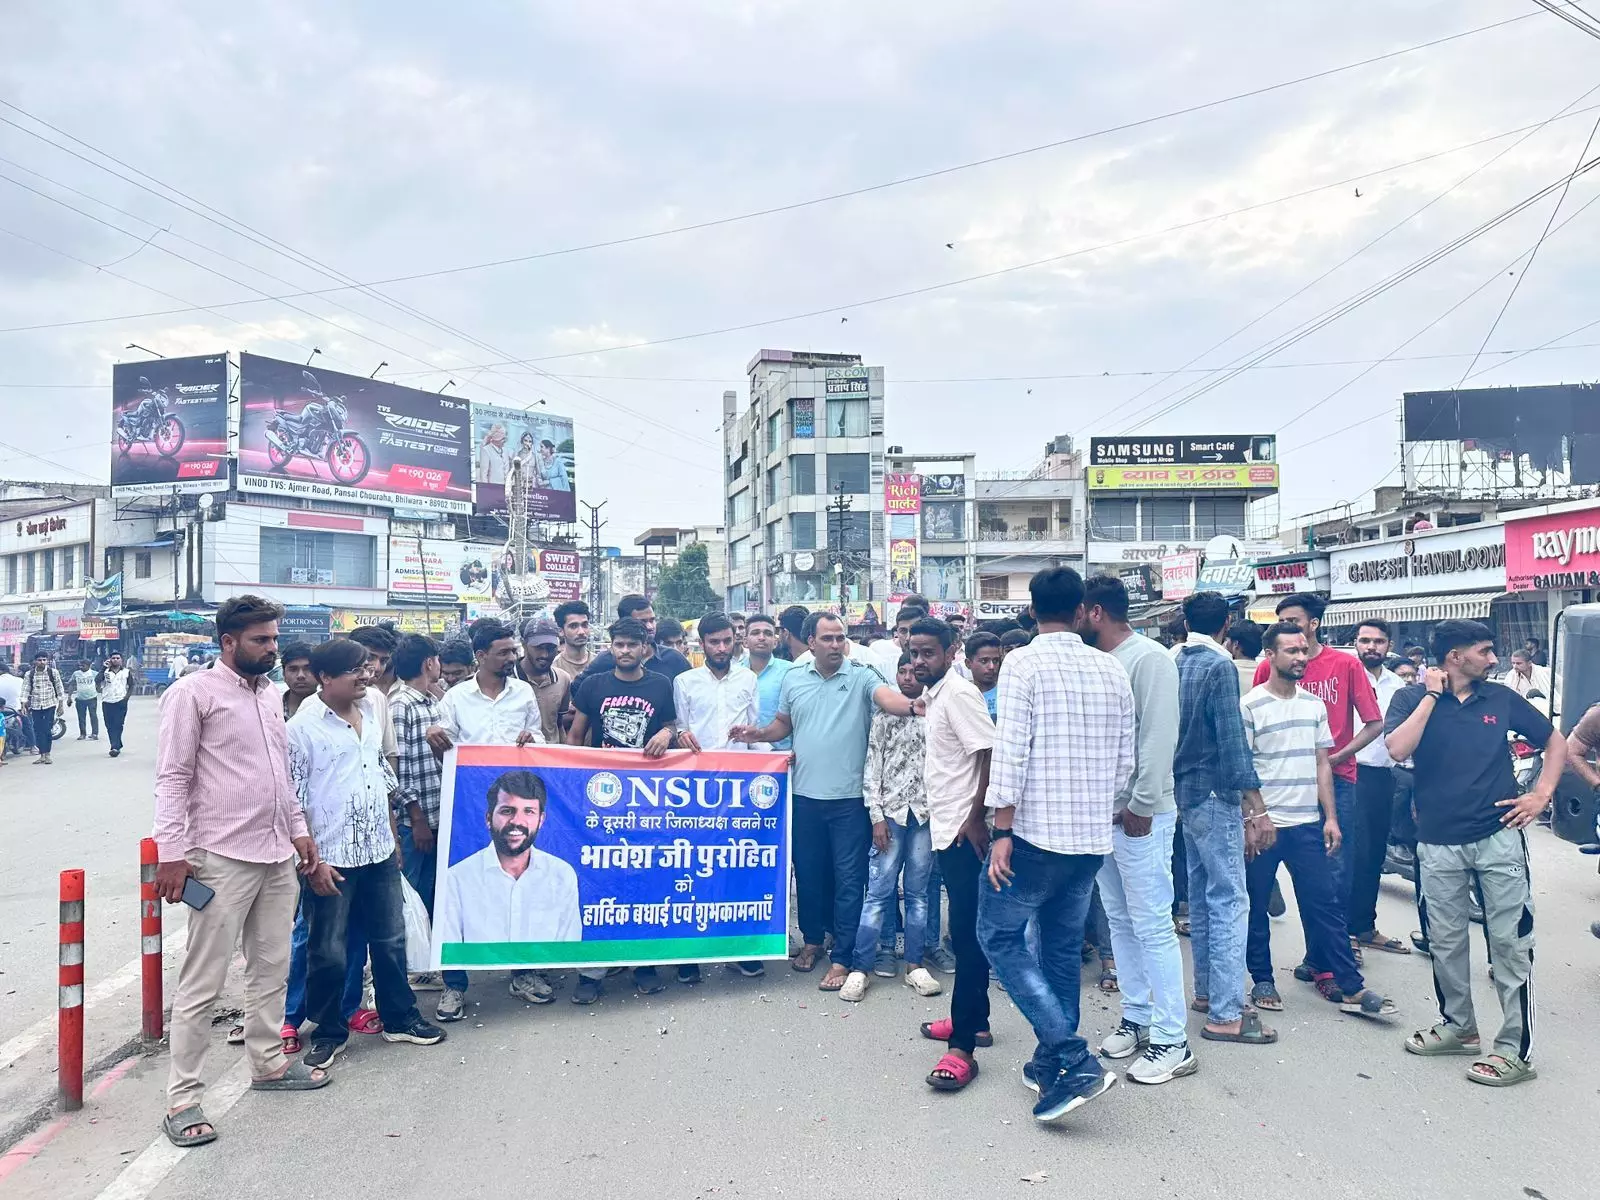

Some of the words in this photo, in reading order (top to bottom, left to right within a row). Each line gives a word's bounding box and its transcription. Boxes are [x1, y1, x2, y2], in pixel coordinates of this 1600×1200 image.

[828, 383, 850, 392] प्रताप
[440, 400, 454, 408] TVS
[377, 411, 461, 438] RAIDER
[380, 436, 434, 452] FASTEST
[1097, 444, 1174, 456] SAMSUNG
[1190, 442, 1214, 451] Smart
[1202, 469, 1236, 480] ठाठ
[244, 477, 268, 488] VINOD
[270, 480, 286, 490] TVS:
[288, 483, 310, 492] Ajmer
[312, 485, 332, 496] Road,
[334, 488, 357, 497] Pansal
[359, 490, 393, 503] Chouraha,
[396, 495, 422, 506] Bhilwara
[888, 485, 918, 497] Rich
[888, 497, 918, 509] पार्लर
[1532, 527, 1600, 566] Raym
[405, 556, 442, 564] BHILWARA
[545, 553, 574, 564] SWIFT
[1348, 556, 1408, 583] GANESH
[1411, 543, 1506, 576] HANDLOOM
[545, 563, 575, 572] COLLEGE
[1257, 563, 1309, 580] WELCOME
[1509, 574, 1536, 582] Authorised
[1534, 572, 1585, 588] GAUTAM
[282, 618, 324, 626] PORTRONICS
[626, 776, 745, 808] NSUI
[585, 810, 600, 828] के
[603, 811, 636, 834] दूसरी
[640, 816, 662, 829] बार
[665, 811, 728, 830] जिलाध्यक्ष
[732, 812, 761, 830] बनने
[764, 817, 777, 829] पर
[581, 838, 655, 868] भावेश
[658, 838, 694, 868] जी
[696, 838, 778, 877] पुरोहित
[675, 874, 694, 893] को
[583, 897, 630, 926] हार्दिक
[632, 896, 670, 928] बधाई
[672, 896, 696, 924] एवं
